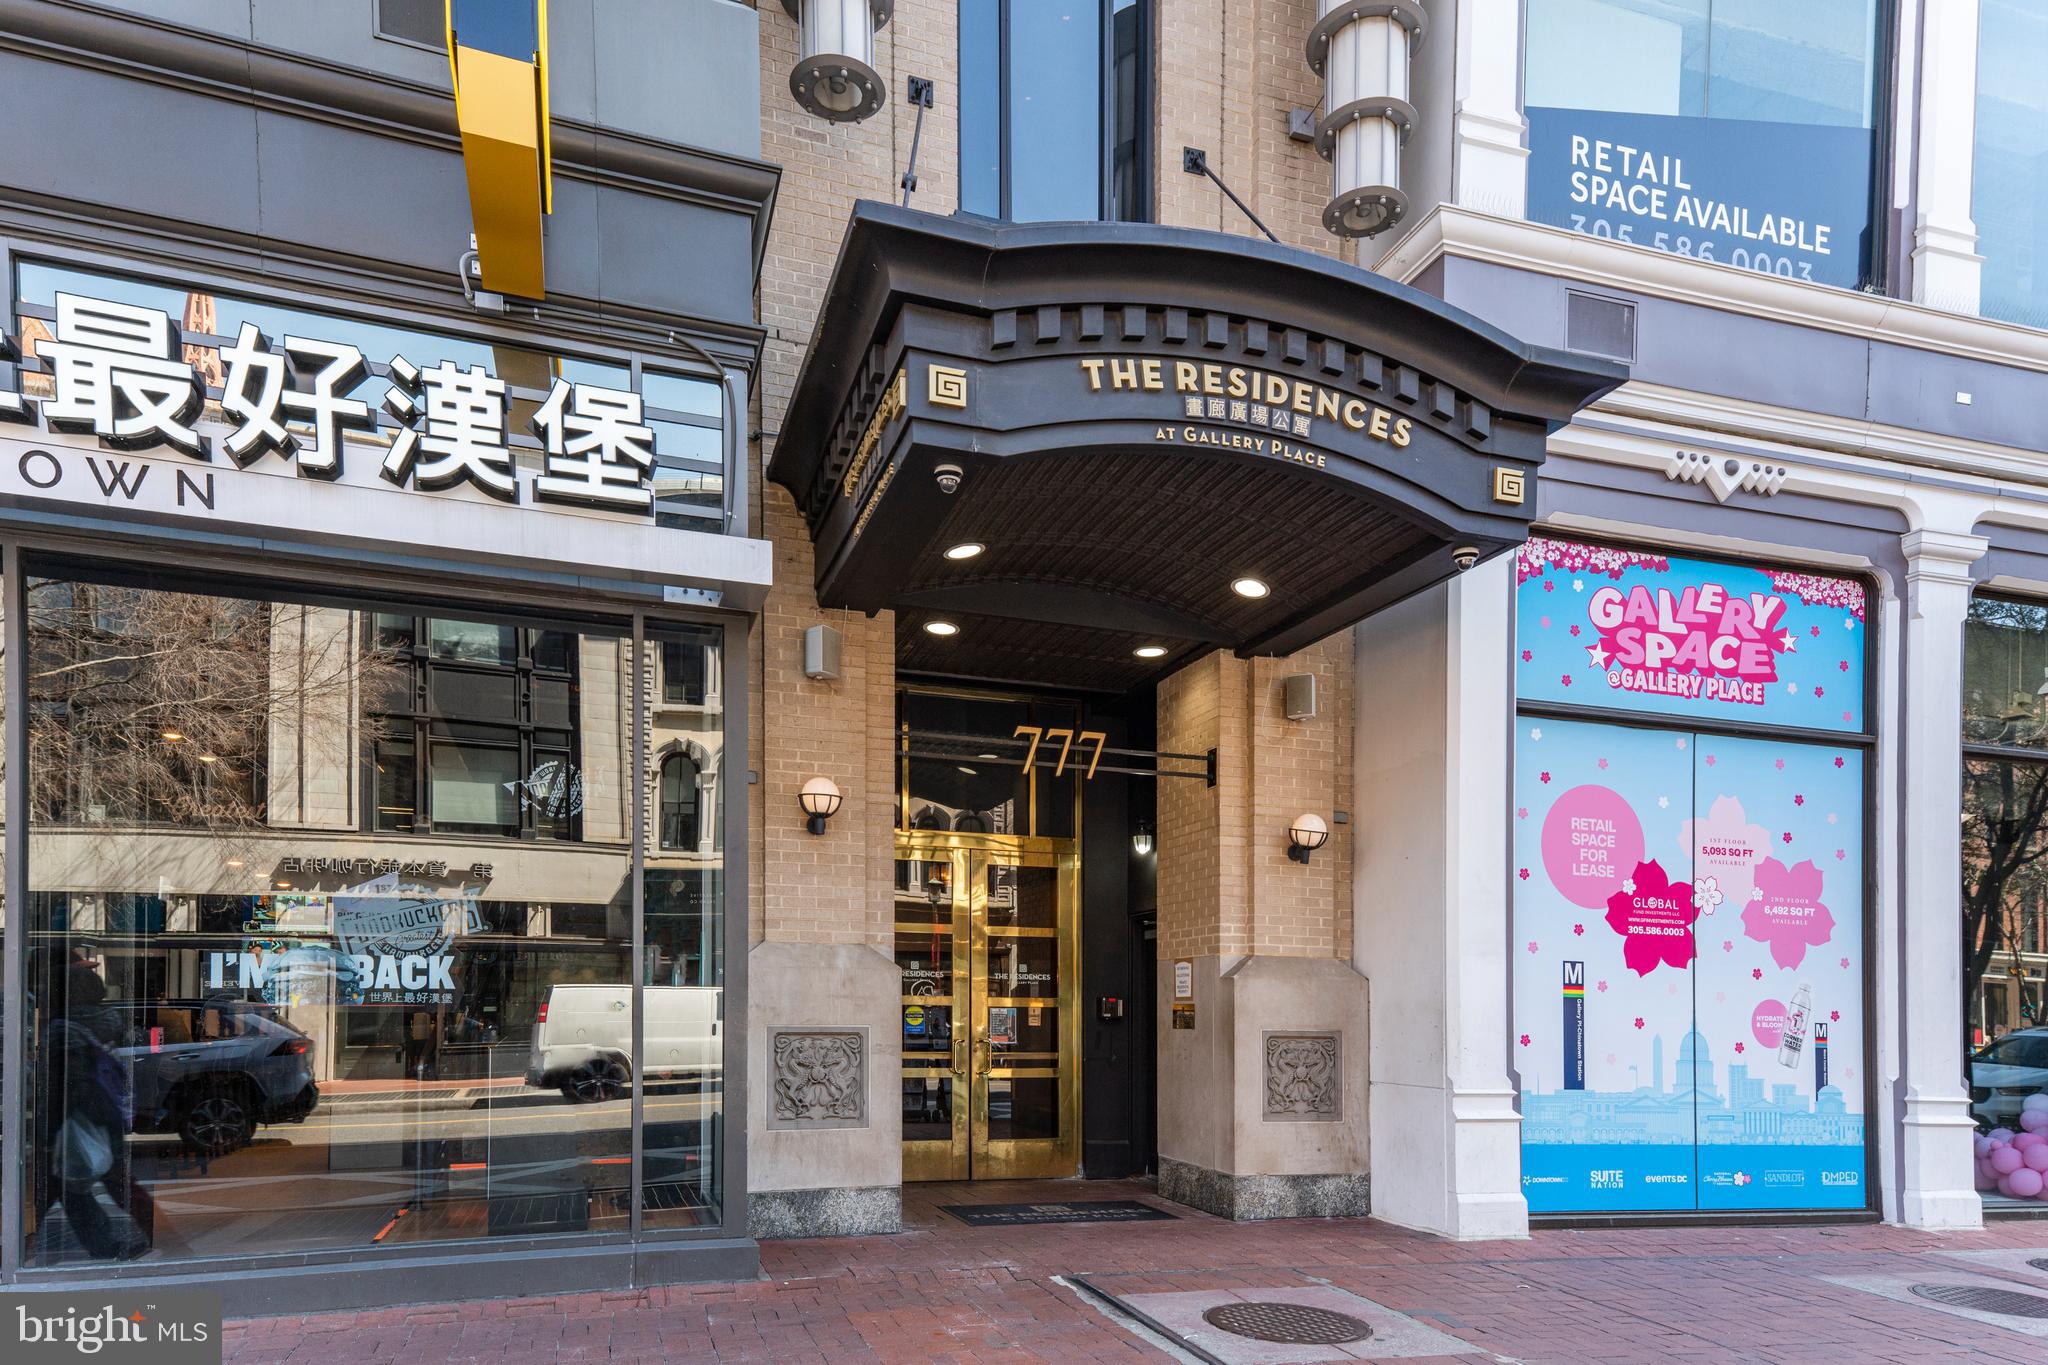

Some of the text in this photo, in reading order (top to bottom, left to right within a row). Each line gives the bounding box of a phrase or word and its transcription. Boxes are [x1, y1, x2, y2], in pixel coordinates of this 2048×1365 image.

[1572, 135, 1691, 190] RETAIL
[1570, 171, 1831, 254] SPACE AVAILABLE
[0, 291, 655, 510] 最好漢堡
[1081, 359, 1412, 447] THE RESIDENCES
[1185, 396, 1311, 438] 畫廊廣場公寓
[1155, 427, 1326, 468] AT GALLERY PLACE
[18, 450, 214, 510] OWN
[1589, 583, 1782, 639] GALLERY
[1615, 627, 1772, 674] SPACE
[1608, 668, 1764, 703] @GALLERY PLACE
[1013, 725, 1106, 780] 777
[1571, 817, 1617, 833] RETAIL
[1572, 833, 1616, 848] SPACE
[1580, 848, 1608, 862] FOR
[1702, 846, 1754, 858] 5,093 SQ FT
[1572, 863, 1616, 878] LEASE
[1710, 859, 1746, 867] AVAILABLE
[1764, 905, 1816, 918] 6,492 SQ FT
[1772, 918, 1809, 926] AVAILABLE
[1628, 925, 1685, 937] 305.586.0003
[350, 953, 456, 991] BACK
[1565, 962, 1583, 985] M
[369, 991, 454, 1005] 世界上最好漢堡
[1816, 1023, 1827, 1038] M
[1590, 1170, 1624, 1182] SUITE
[1767, 1173, 1802, 1183] SANDLOT
[1591, 1181, 1624, 1189] NATION
